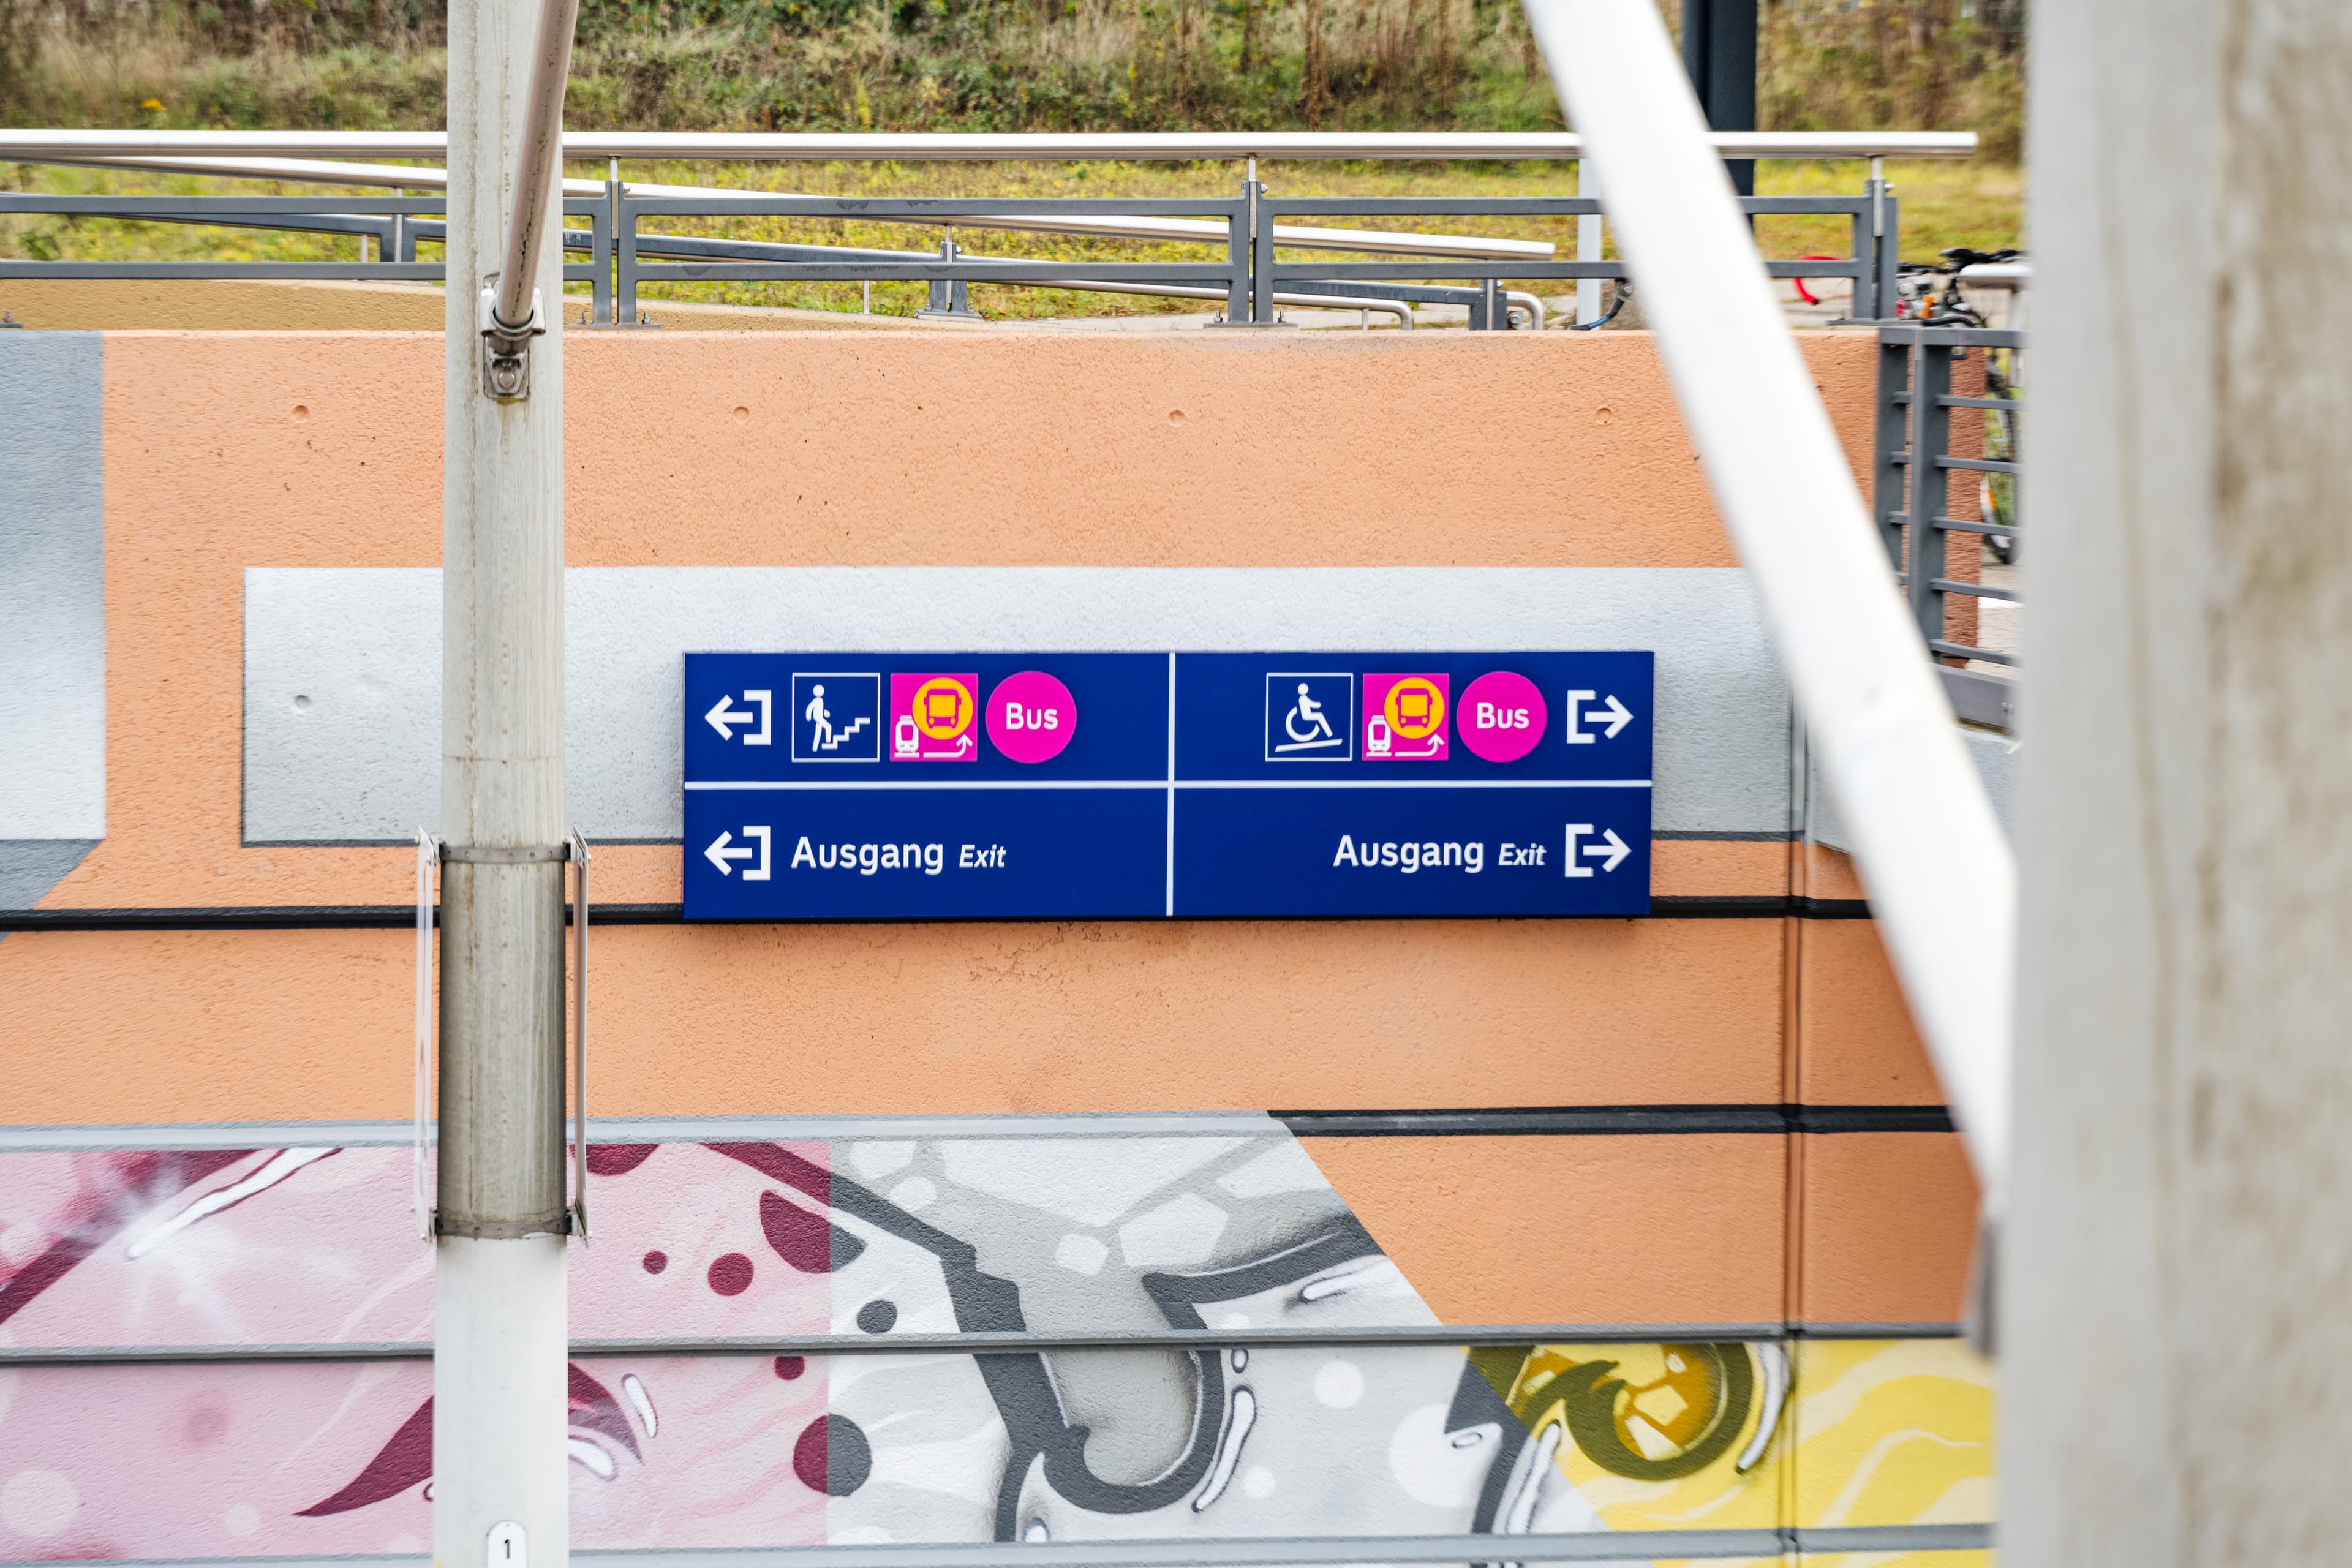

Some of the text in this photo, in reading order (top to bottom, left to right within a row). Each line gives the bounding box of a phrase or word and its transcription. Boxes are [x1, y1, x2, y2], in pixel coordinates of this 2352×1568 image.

[1006, 702, 1058, 730] Bus
[1477, 702, 1529, 729] Bus
[791, 836, 1007, 876] Ausgang Exit
[1333, 834, 1547, 875] Ausgang Exit
[504, 1539, 510, 1559] 1
